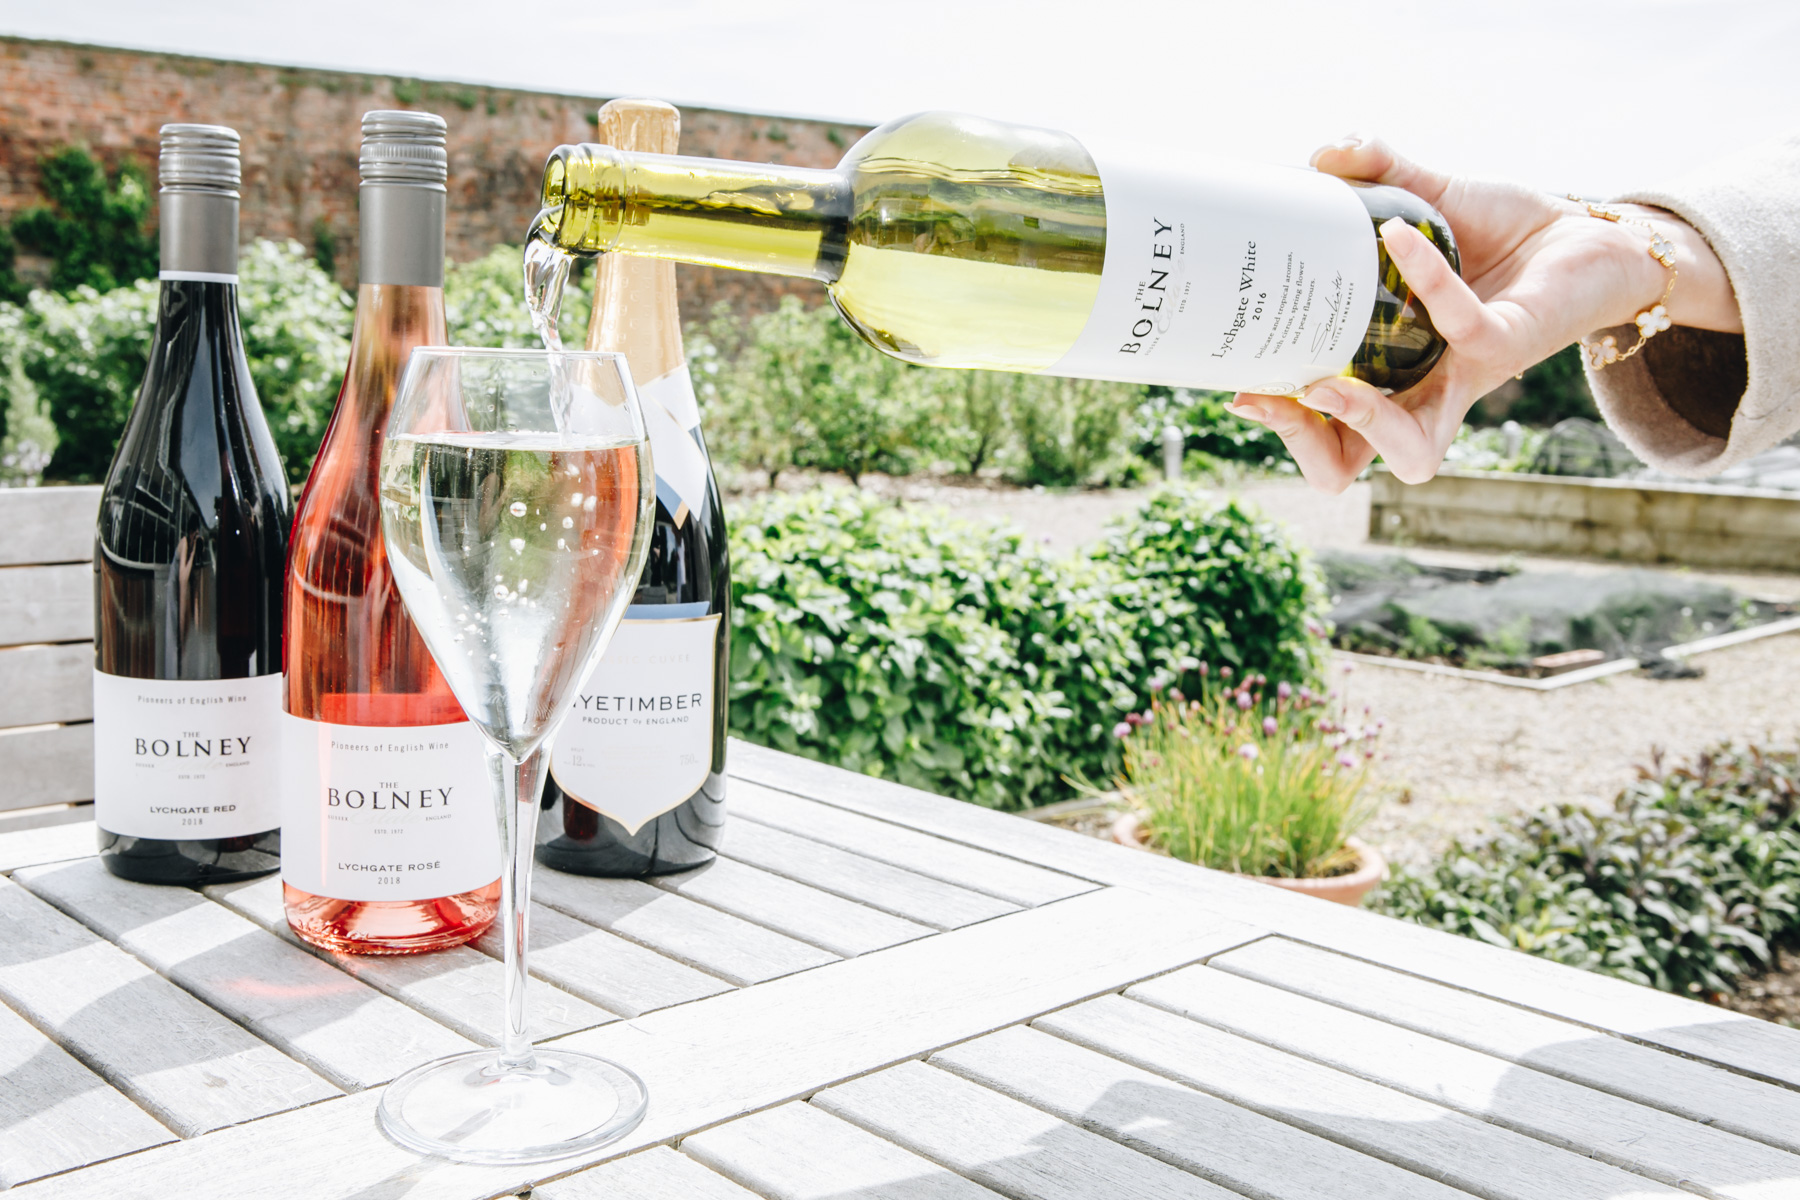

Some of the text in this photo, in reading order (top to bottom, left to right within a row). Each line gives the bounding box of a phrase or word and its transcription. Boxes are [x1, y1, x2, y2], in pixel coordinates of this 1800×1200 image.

[1118, 217, 1173, 355] BOLNEY
[1135, 280, 1146, 302] THE
[1183, 280, 1192, 296] 1972
[1211, 240, 1257, 359] Lychgate White
[1252, 291, 1267, 321] 2016
[1254, 251, 1294, 360] Delicate and tropical aromas,
[1272, 260, 1306, 355] with citrus, spring flower
[1291, 277, 1316, 346] and pear flavours.
[1328, 281, 1355, 352] MASTER WINEMAKER
[600, 655, 641, 665] ASSIC
[137, 694, 248, 706] Pioneers of English Wine
[573, 692, 703, 712] YETIMBER
[582, 715, 628, 726] PRODUCT
[646, 715, 690, 726] ENGLAND
[134, 736, 252, 757] BOLNEY
[331, 740, 449, 754] Pioneers of English Wine
[379, 781, 399, 789] THE
[327, 786, 454, 810] BOLNEY
[149, 804, 237, 815] LYCHGATE RED
[425, 813, 453, 822] ENGLAND
[181, 818, 204, 826] 2018
[337, 860, 442, 873] LYCHGATE ROSÉ
[377, 876, 401, 885] 2018
